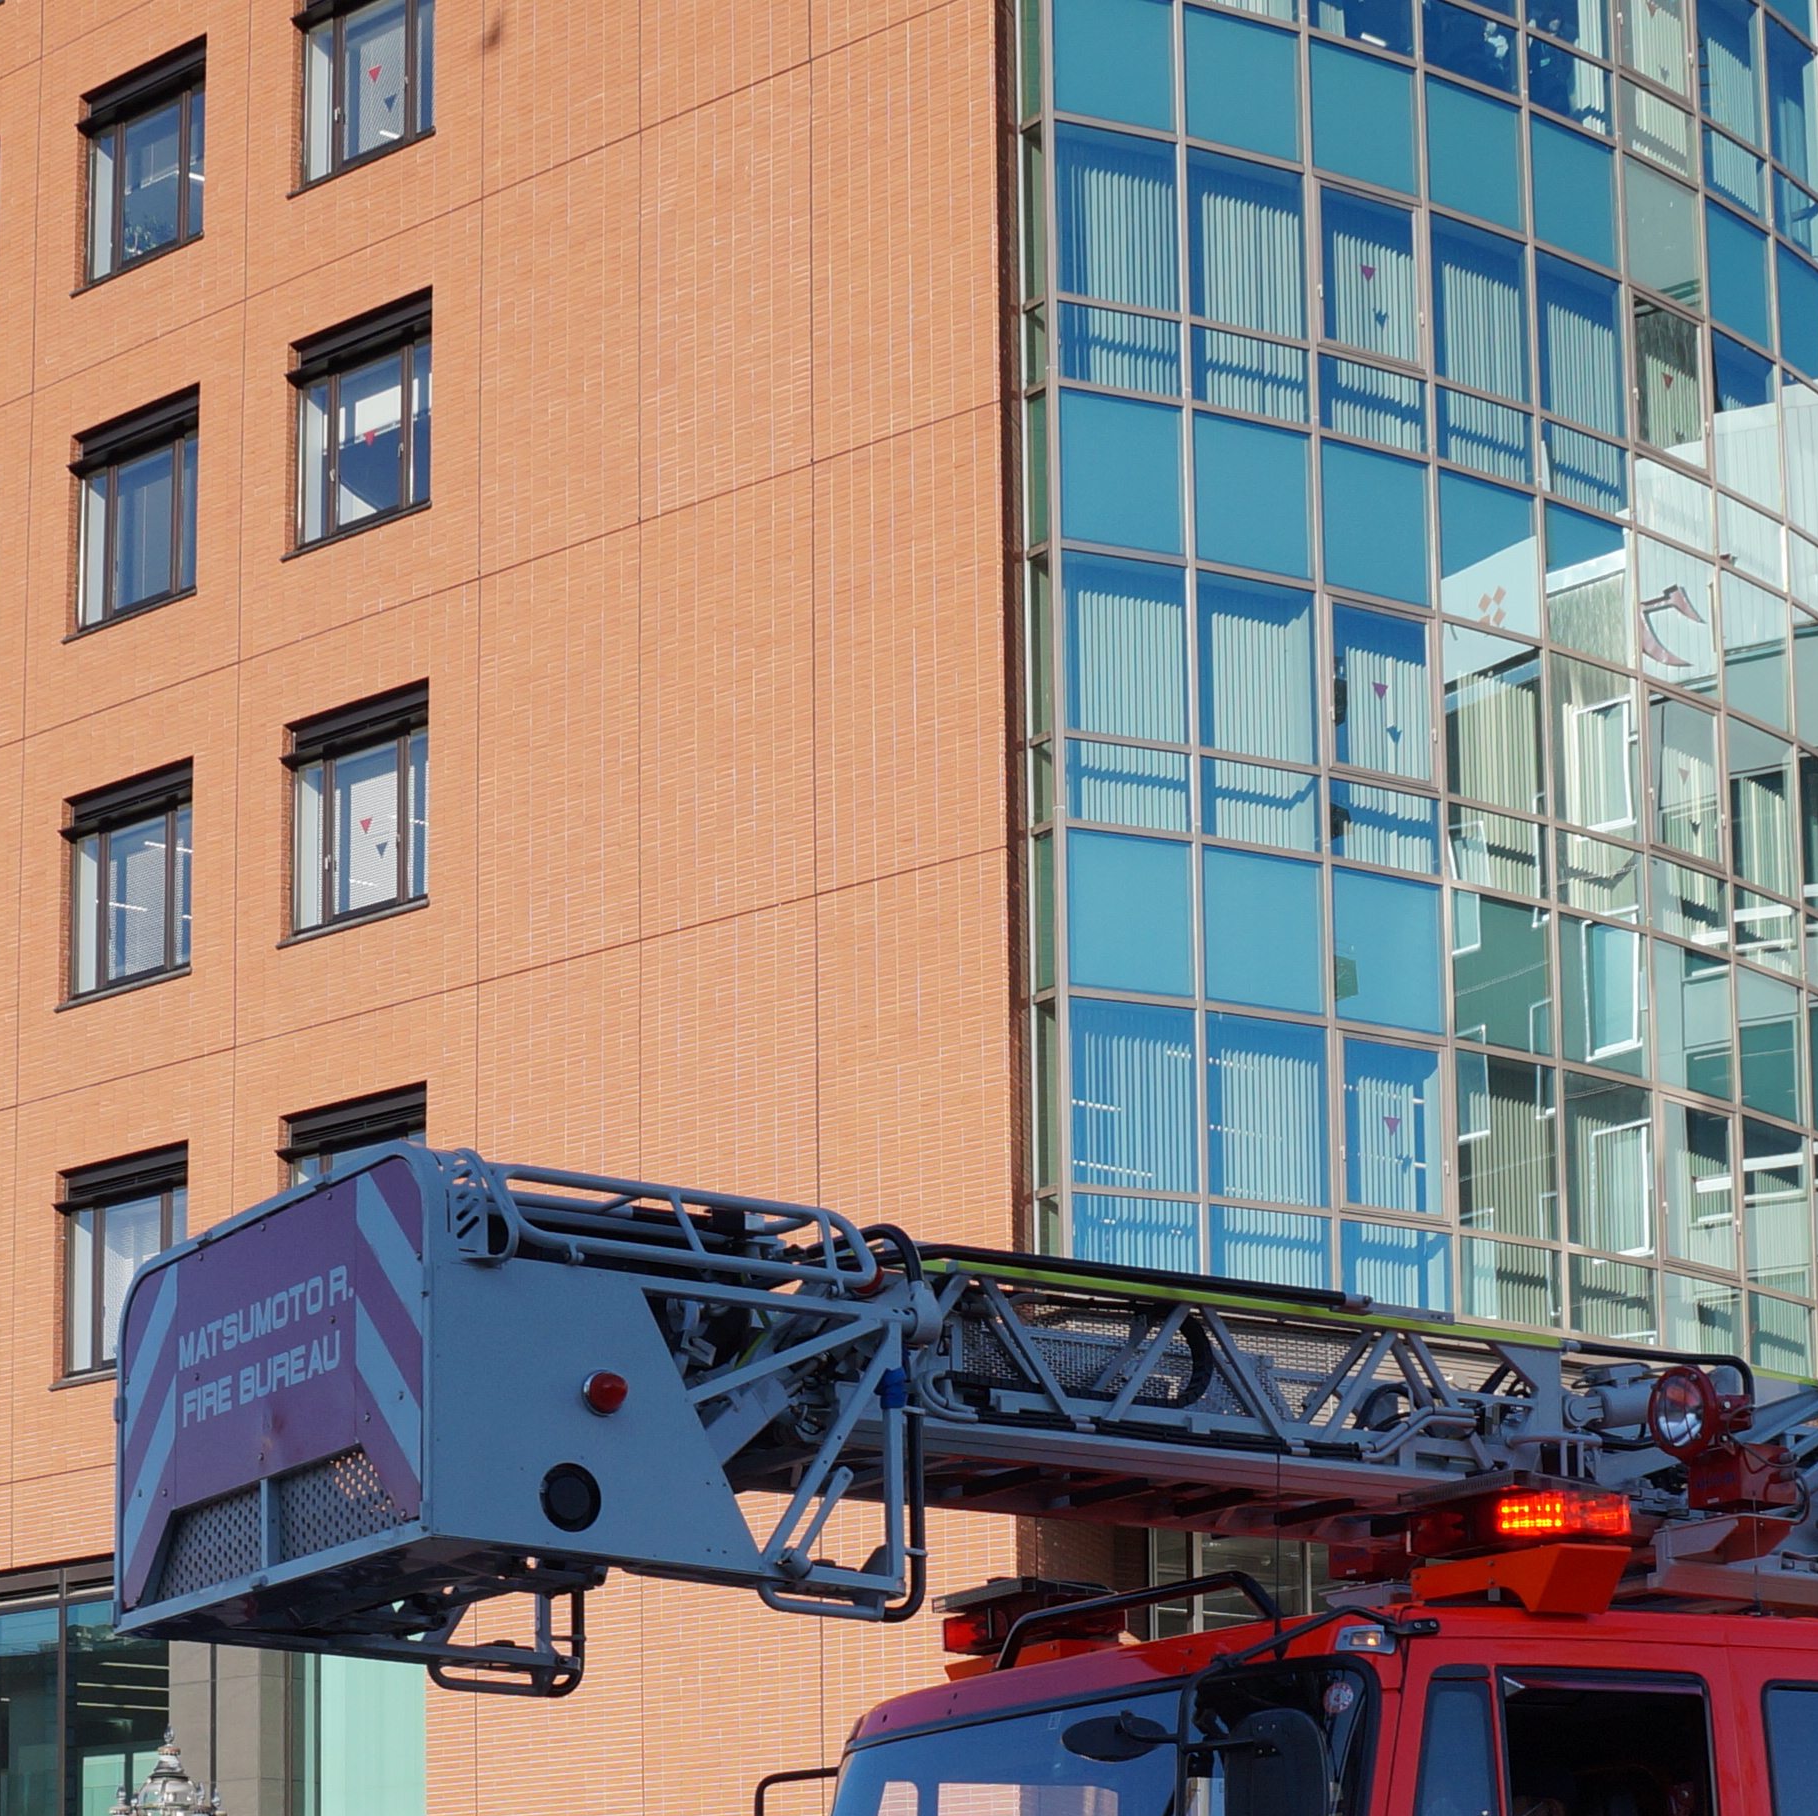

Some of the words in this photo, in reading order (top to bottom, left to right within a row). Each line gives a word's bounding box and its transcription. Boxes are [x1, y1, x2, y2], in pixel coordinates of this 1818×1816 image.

[179, 1276, 324, 1371] MATSUMOTO
[329, 1265, 355, 1307] R.
[183, 1375, 233, 1428] FIRE
[239, 1329, 341, 1405] BUREAU
